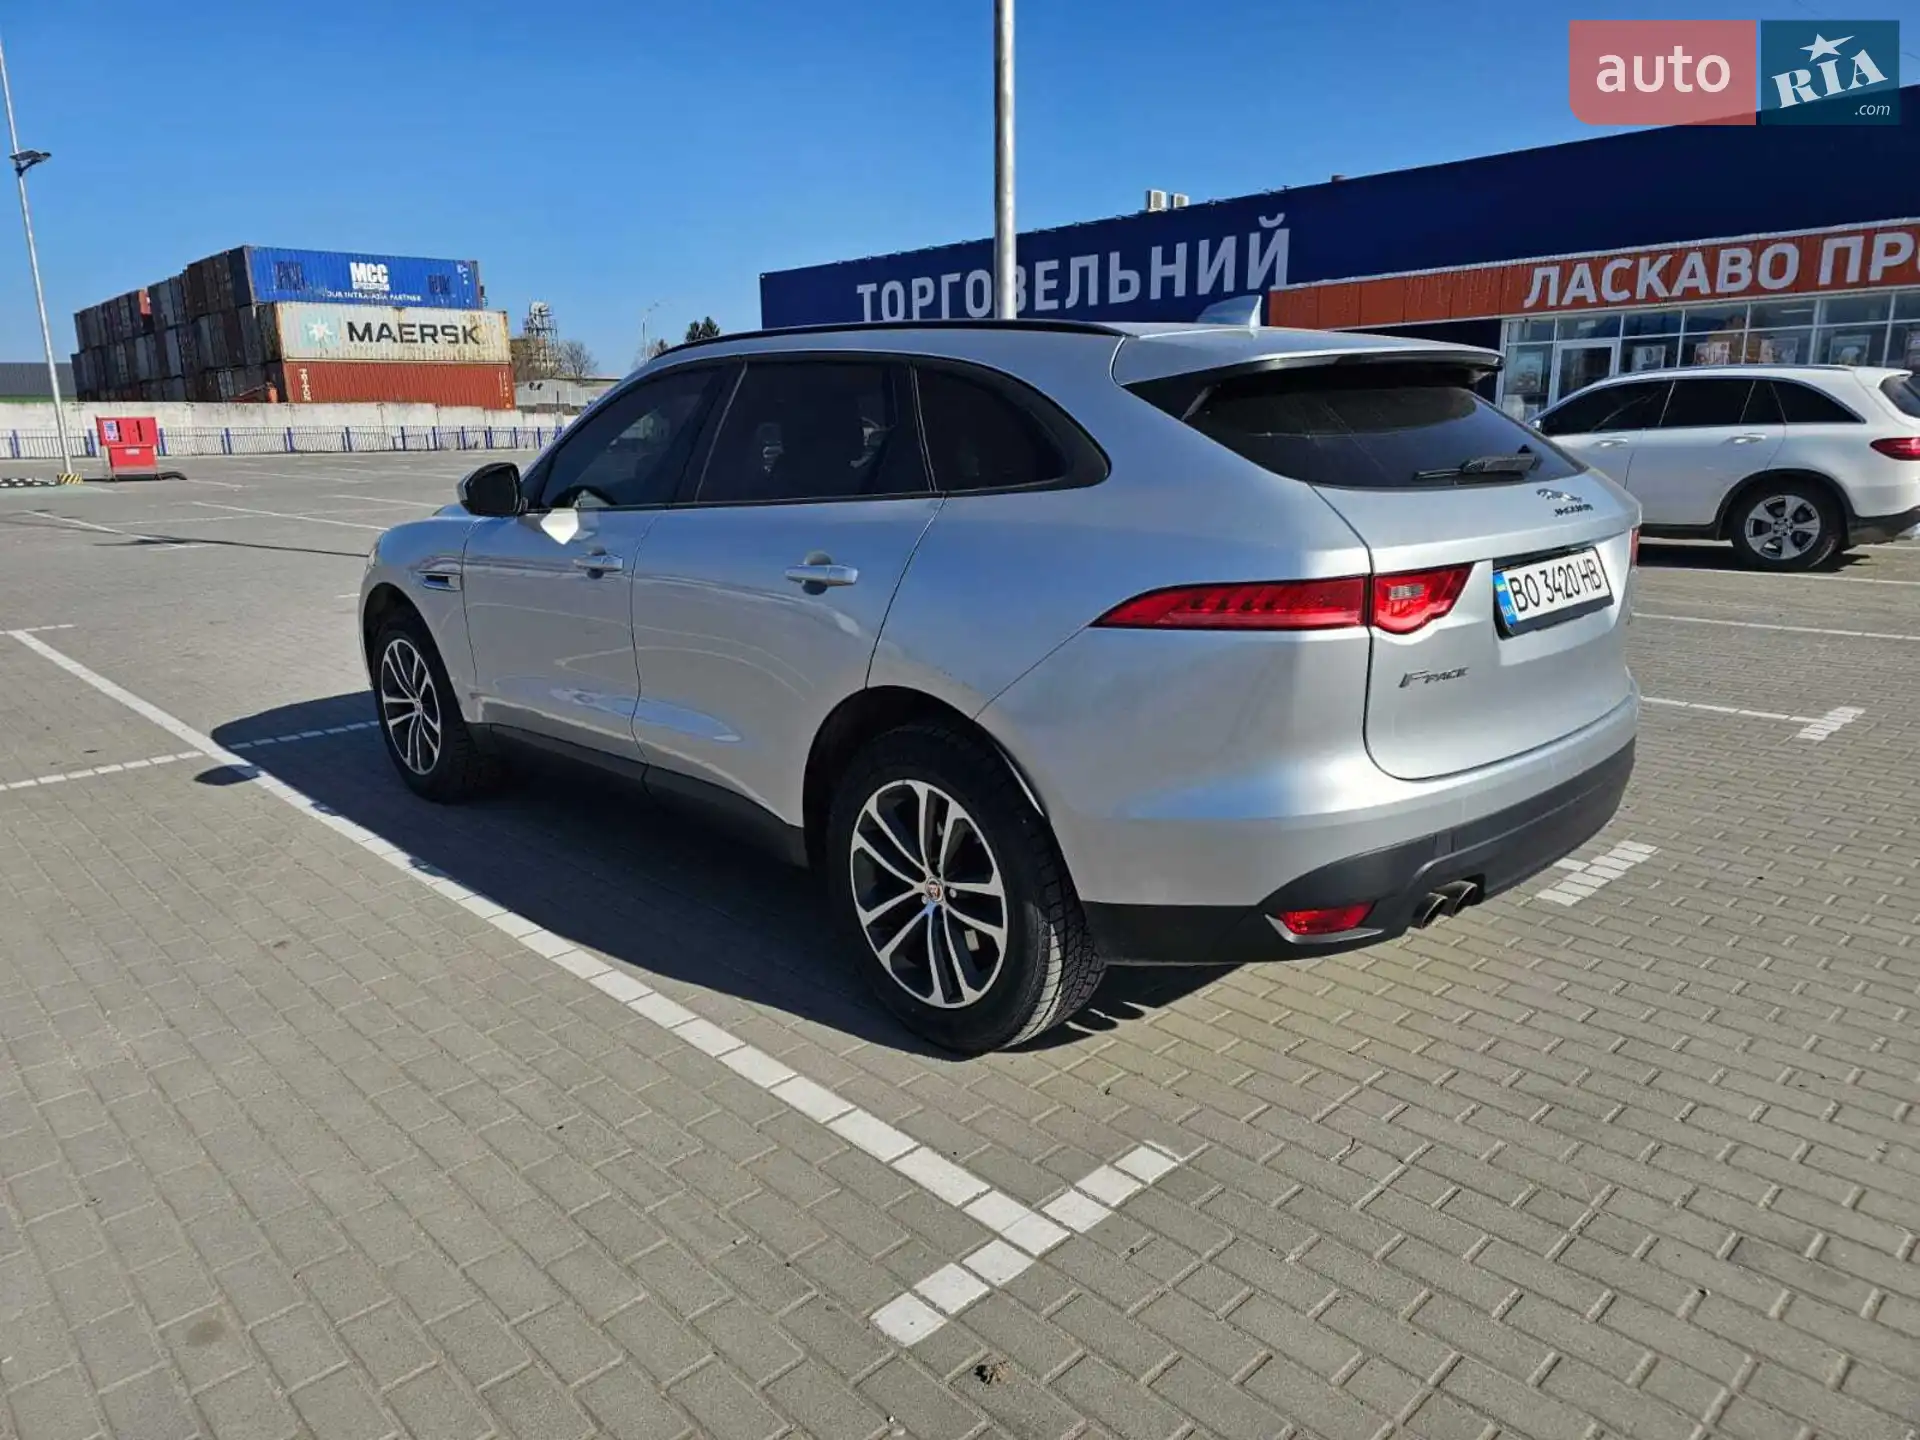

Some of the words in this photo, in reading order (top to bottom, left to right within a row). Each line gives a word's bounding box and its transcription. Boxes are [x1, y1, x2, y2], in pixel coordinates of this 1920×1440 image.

[350, 262, 389, 284] MCC
[1523, 242, 1800, 309] ЛАСКАВО
[1818, 231, 1920, 286] ПР
[347, 321, 481, 346] MAERSK
[1508, 574, 1540, 612] BO
[1539, 563, 1581, 604] 3420
[1577, 558, 1602, 594] HB
